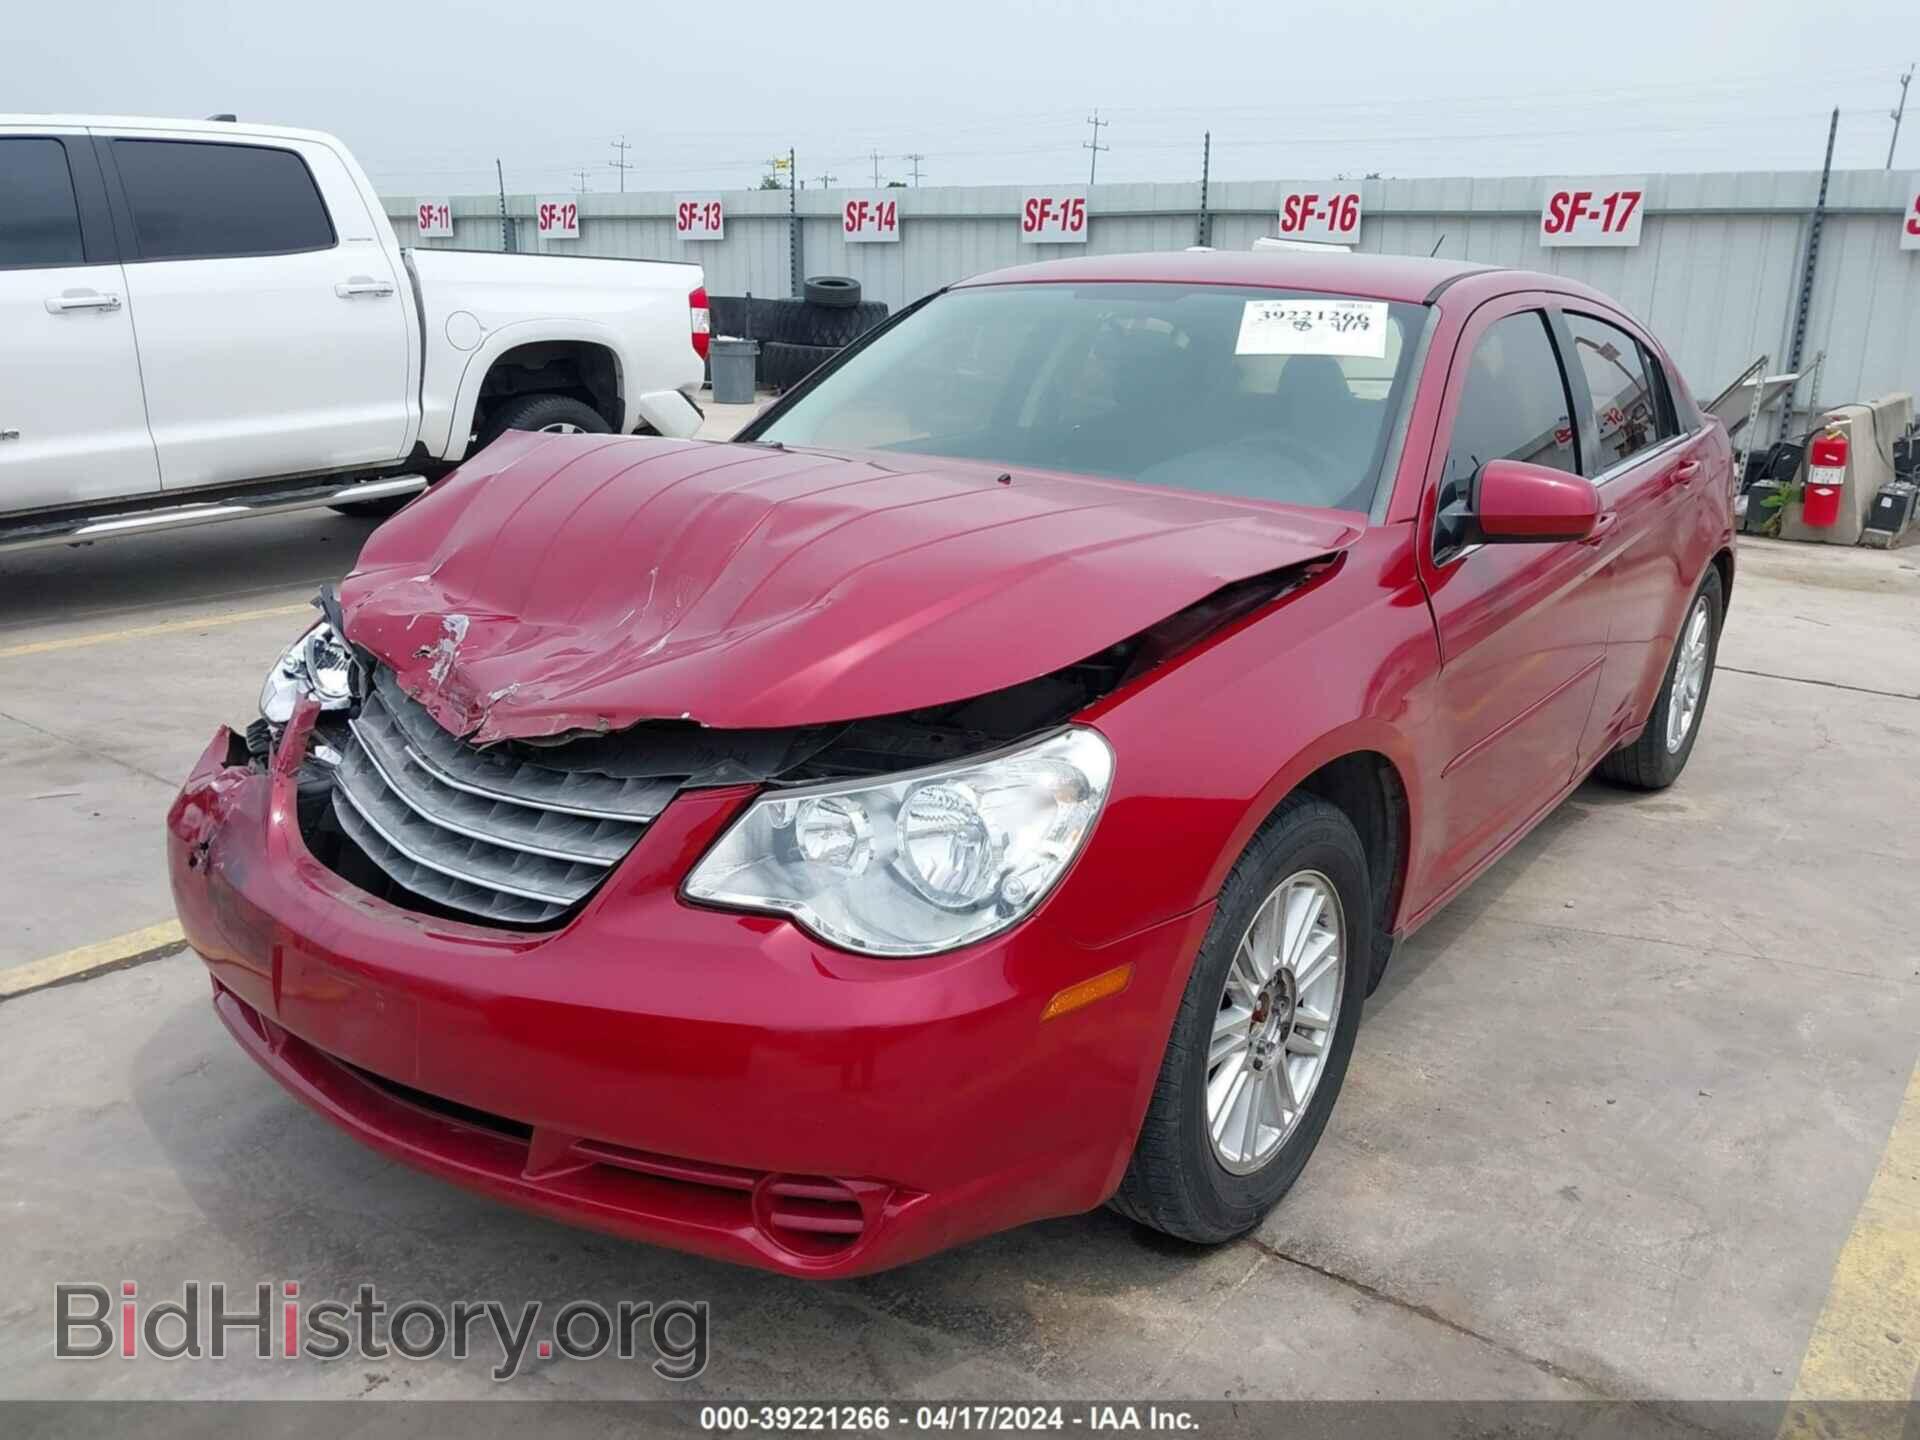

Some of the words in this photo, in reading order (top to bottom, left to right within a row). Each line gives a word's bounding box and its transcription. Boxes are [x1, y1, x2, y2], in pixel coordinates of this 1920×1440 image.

[418, 205, 449, 229] SF-11
[539, 205, 577, 231] SF-12
[677, 202, 721, 231] SF-13
[845, 200, 897, 232] SF-14
[1023, 198, 1085, 232] SF-15
[1280, 193, 1361, 233] SF-16
[1543, 191, 1642, 235] SF-17
